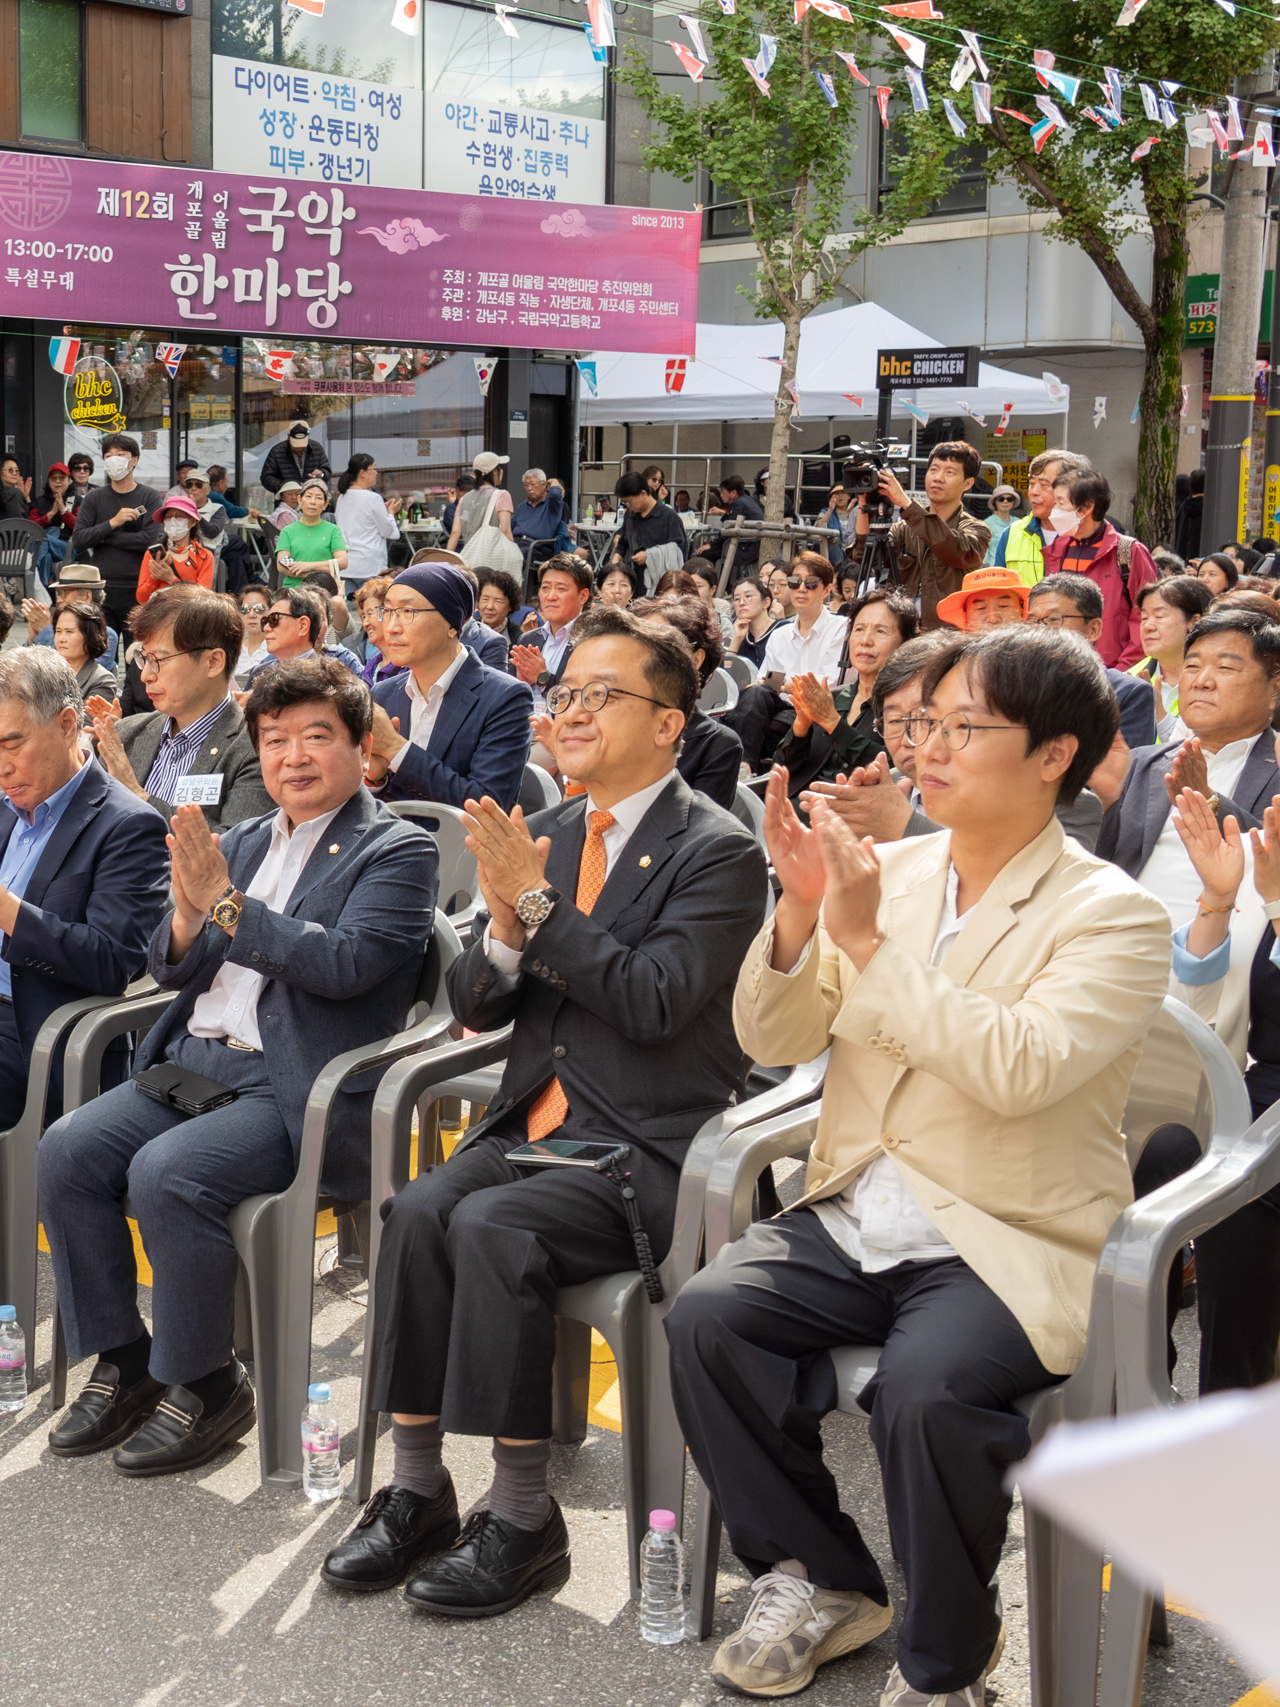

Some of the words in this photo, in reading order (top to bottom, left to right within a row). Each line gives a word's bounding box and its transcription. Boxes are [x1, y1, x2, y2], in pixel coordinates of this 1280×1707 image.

[96, 187, 175, 221] 제12회
[184, 180, 204, 240] 개포골
[210, 190, 230, 249] 어울림
[238, 186, 357, 256] 국악
[631, 213, 658, 229] since
[660, 216, 685, 229] 2013
[4, 238, 114, 263] 13:00-17:00
[4, 267, 75, 291] 특설무대
[163, 252, 353, 328] 한마당
[477, 271, 510, 288] 개포골
[512, 273, 545, 290] 어울림
[547, 275, 599, 294] 국악한마당
[601, 279, 653, 297] 추진위원회
[476, 289, 516, 306] 개포4동
[518, 291, 540, 308] 직능
[598, 298, 636, 314] 개포4동
[638, 300, 679, 316] 주민센터
[517, 310, 601, 329] 국립국악고등학교
[880, 356, 911, 376] bhc
[913, 360, 965, 375] CHICKEN
[75, 371, 113, 399] bhc
[71, 397, 118, 420] chicken
